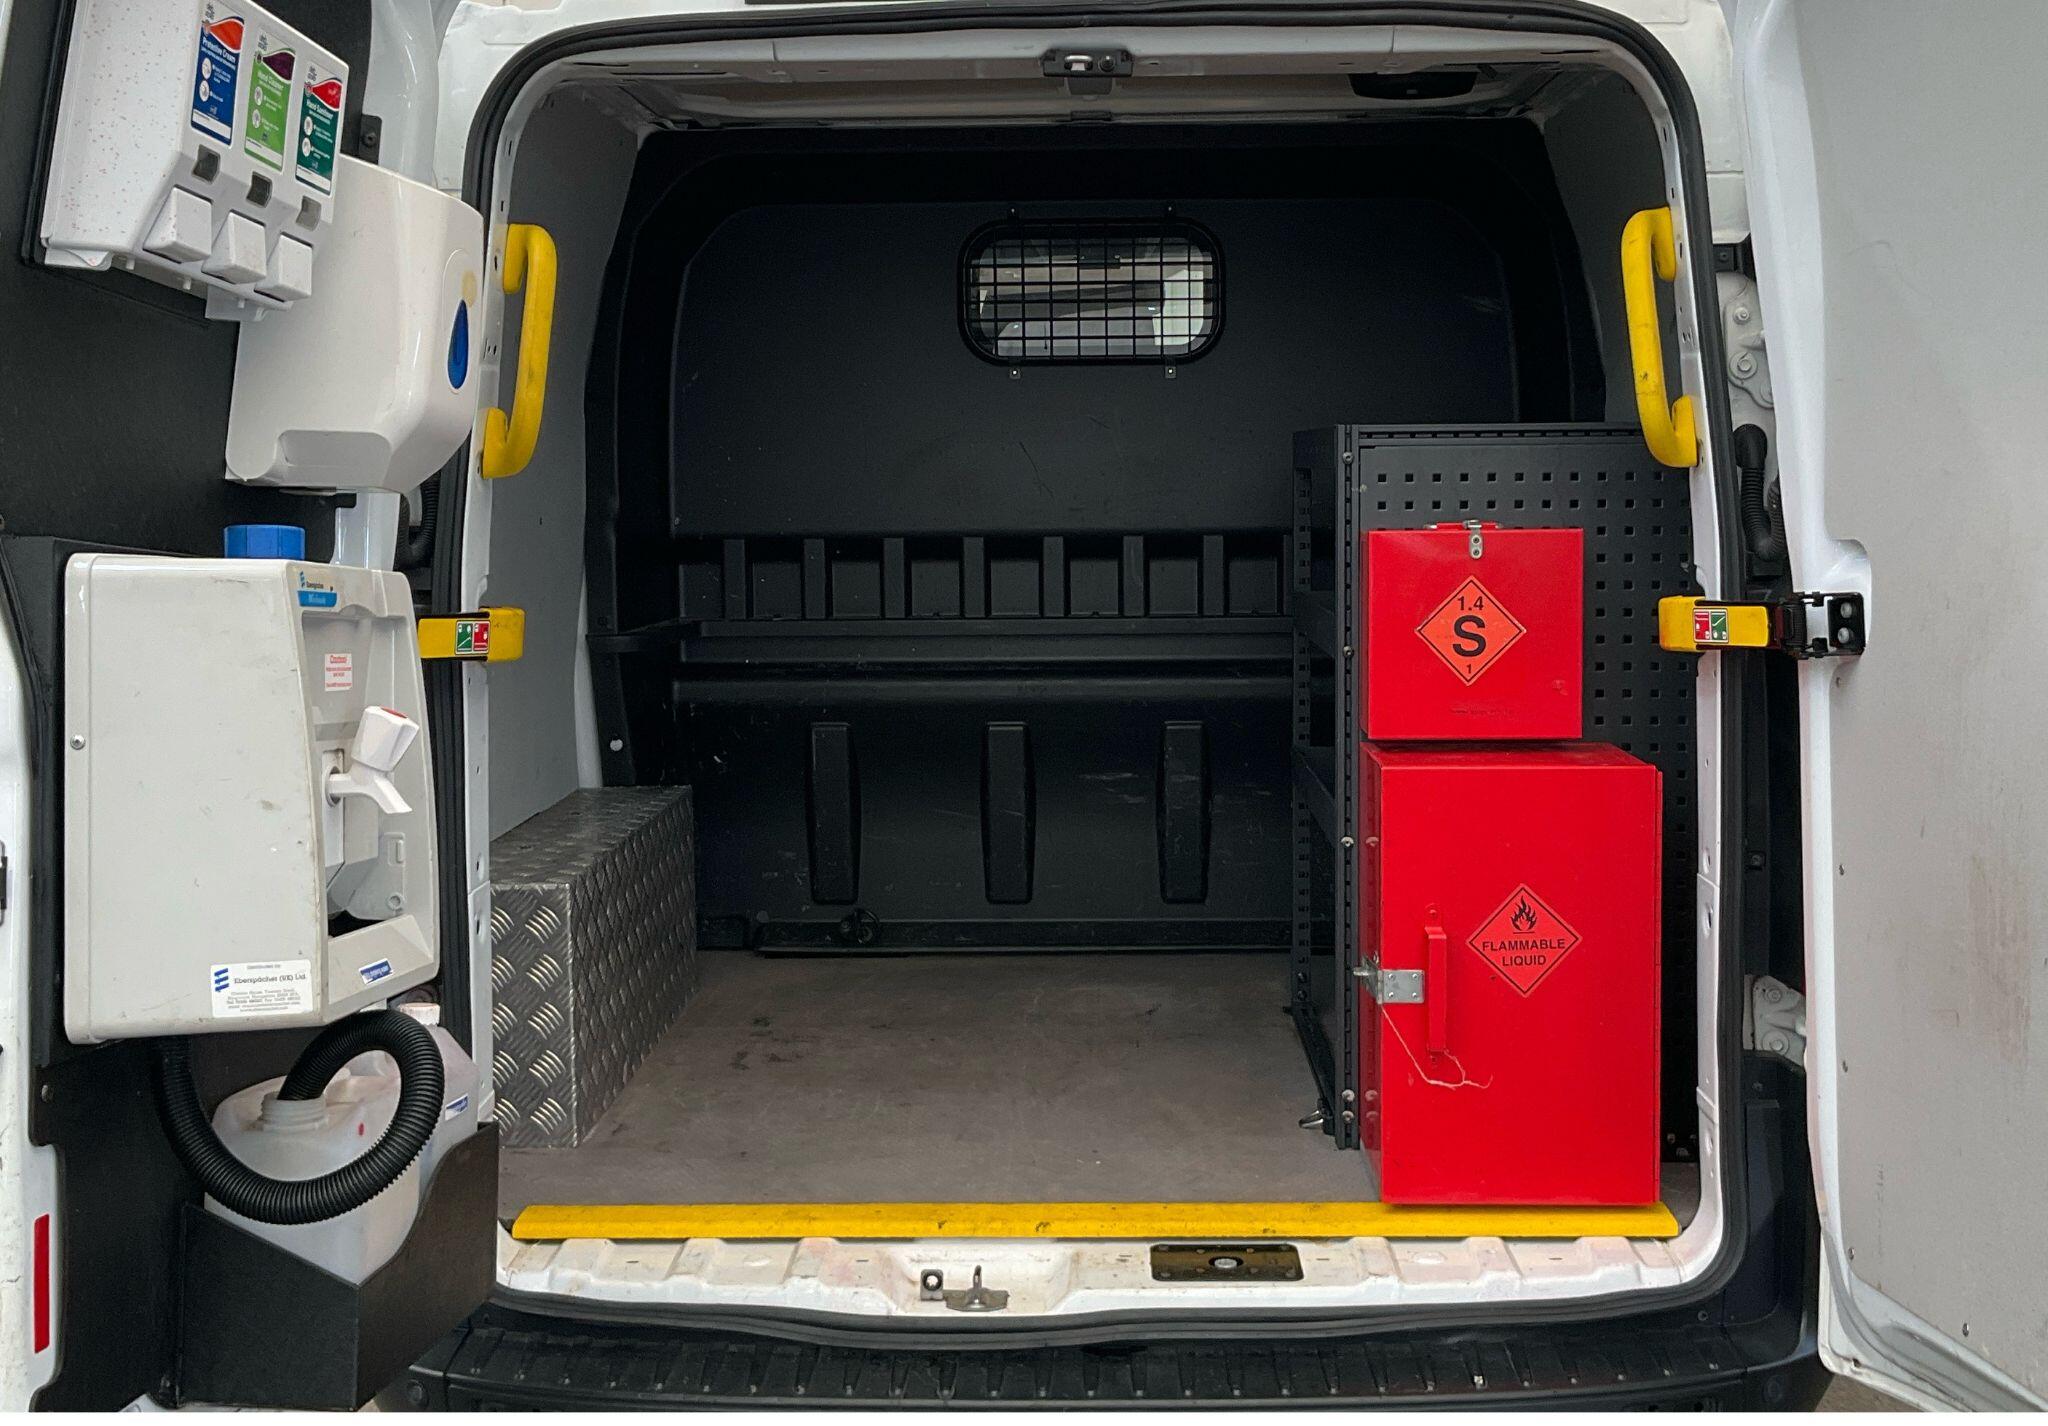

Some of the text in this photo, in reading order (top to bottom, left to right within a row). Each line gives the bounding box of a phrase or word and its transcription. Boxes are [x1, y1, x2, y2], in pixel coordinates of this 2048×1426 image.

[202, 36, 223, 56] Protective
[222, 49, 236, 64] Cream
[1457, 596, 1484, 611] 1.4
[1452, 615, 1487, 658] S
[1466, 664, 1473, 674] 1
[1482, 939, 1565, 951] FLAMMABLE
[1502, 955, 1547, 966] LIQUID
